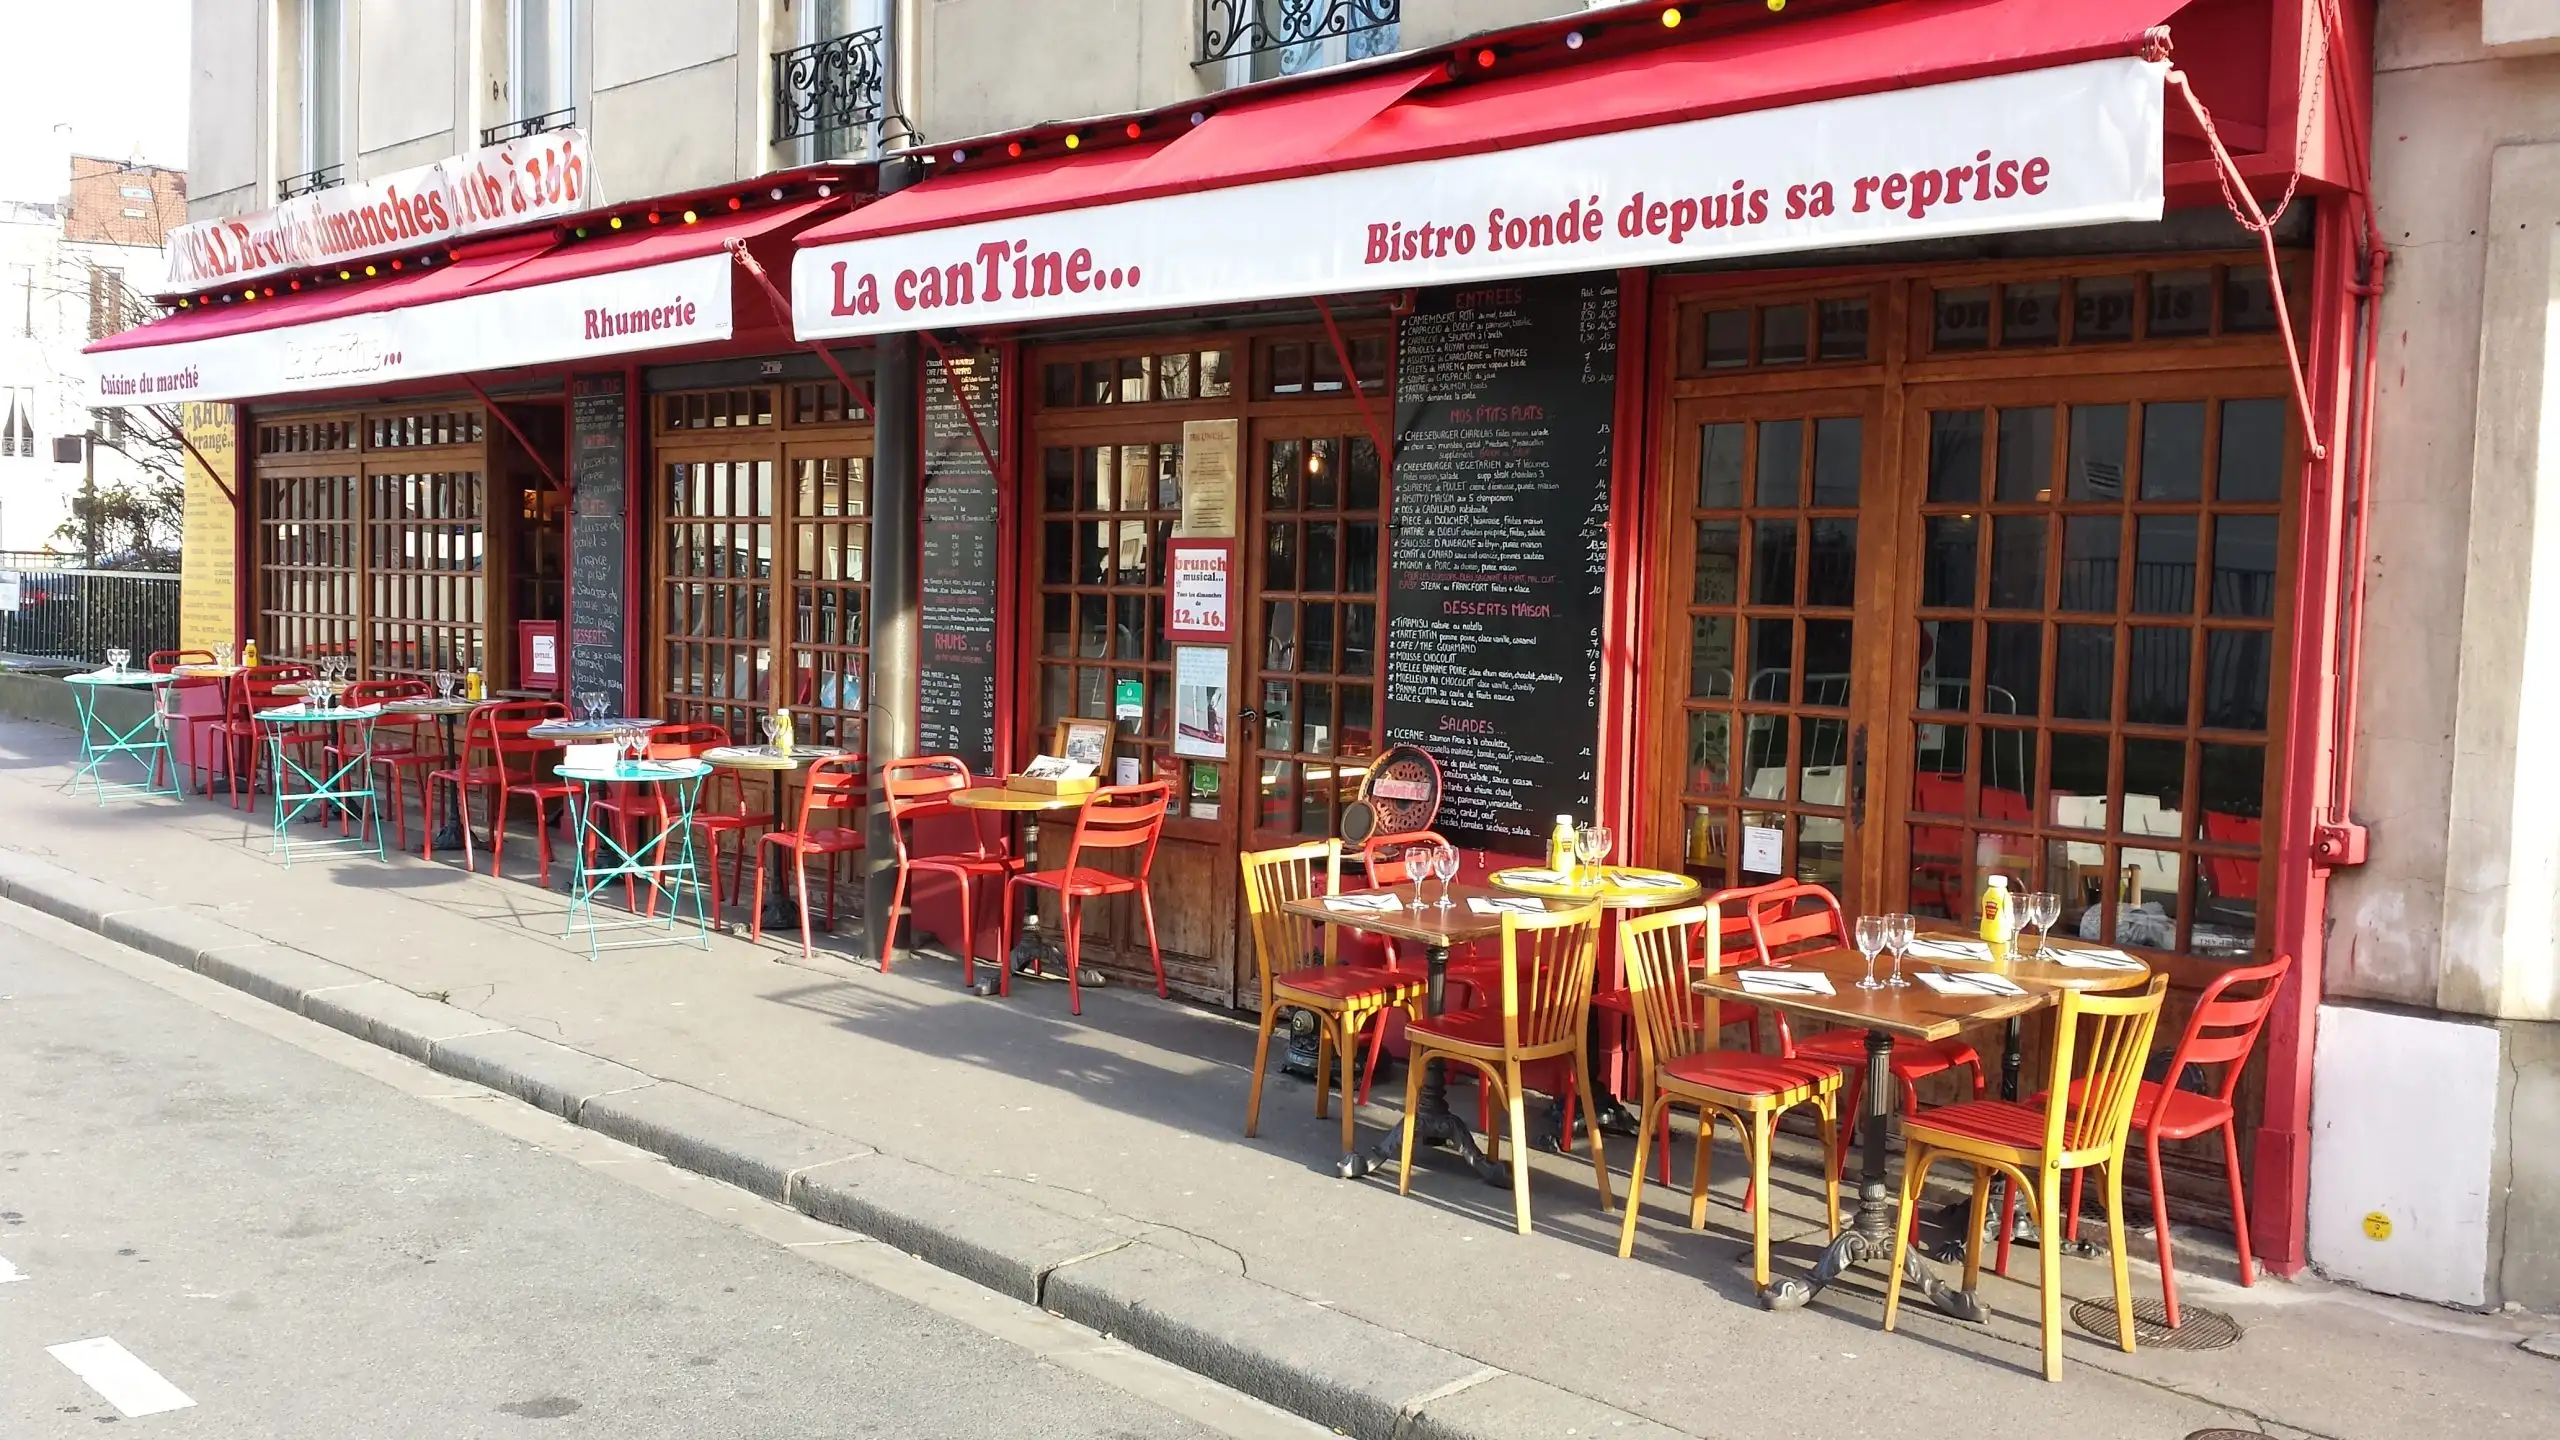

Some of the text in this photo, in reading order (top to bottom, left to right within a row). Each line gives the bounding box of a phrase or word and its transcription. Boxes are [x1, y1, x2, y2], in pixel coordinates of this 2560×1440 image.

[1364, 146, 2050, 266] Bistro fondé depuis sa reprise
[312, 185, 449, 257] dimanches
[830, 237, 1142, 318] La canTine...
[1455, 288, 1522, 308] ENTREES
[583, 294, 696, 341] Rhumerie
[1408, 311, 1456, 326] CAMEMBERT
[1453, 322, 1476, 332] BOEUF
[1494, 348, 1528, 358] FROMAGES
[1407, 364, 1428, 374] FILETS
[1438, 361, 1464, 372] HARENG
[1584, 352, 1591, 361] 7
[100, 363, 199, 396] Cuisine du marché
[1437, 371, 1472, 382] GASPACHO
[1405, 394, 1424, 402] TAPAS
[1511, 405, 1544, 421] PLATS
[1404, 429, 1459, 441] CHEESEBURGER
[1597, 424, 1610, 434] 13
[1402, 461, 1452, 471] CHEESEBURGER
[1455, 460, 1501, 470] VEGETARIEN
[1539, 470, 1545, 478] 3
[1443, 481, 1467, 491] POULET
[1595, 479, 1606, 489] 14
[1402, 493, 1429, 503] RISOTTO
[1430, 493, 1455, 502] MAISON
[1468, 494, 1474, 502] 5
[1594, 492, 1607, 501] 16
[1401, 505, 1413, 514] DOS
[1422, 504, 1456, 514] CABILLAUD
[1401, 515, 1421, 525] PIECE
[1583, 517, 1595, 525] 15
[1401, 526, 1460, 537] TARTARE BOEUF
[1401, 539, 1431, 548] SAUCISSE
[1434, 537, 1476, 548] D'AUVERGNE
[1427, 550, 1453, 559] CANARD
[1174, 555, 1227, 573] brunch
[1400, 561, 1423, 570] MIGNON
[1434, 560, 1451, 570] PORC
[1182, 572, 1224, 582] musical...
[1196, 591, 1222, 599] dimanches
[1420, 581, 1441, 591] STEAK
[1451, 582, 1488, 592] FRANCFORT
[1588, 585, 1602, 596] 10
[1443, 600, 1550, 618] DESSERTS MAISON
[1396, 617, 1598, 637] TIRAMISU 6
[935, 633, 967, 651] RHUMS
[1396, 630, 1418, 640] TARTE
[1418, 631, 1438, 641] TATIN
[1591, 637, 1598, 648] 7
[1436, 643, 1600, 659] GOURMAND 7/8
[1396, 652, 1596, 672] MOUSSE CHOCOLAT 6
[1396, 662, 1422, 673] POELEE
[1422, 663, 1448, 675] BANANE
[1588, 672, 1597, 683] 7
[1396, 673, 1429, 684] MOELLEUX
[1430, 675, 1439, 685] AU
[1440, 676, 1475, 688] CHOCOLAT
[1588, 686, 1596, 695] 6
[1395, 683, 1417, 695] PANNA
[1417, 685, 1438, 696] COTTA
[1587, 697, 1595, 707] 6
[1396, 694, 1422, 703] GLACES
[1439, 715, 1495, 734] SALADES
[1393, 728, 1424, 741] OCEANE
[1429, 734, 1451, 743] saumon
[1579, 747, 1591, 756] 12
[1459, 759, 1476, 772] poulet
[1492, 775, 1510, 785] sauce
[1473, 784, 1493, 796] chèvre
[1460, 819, 1531, 837] tomates salade
